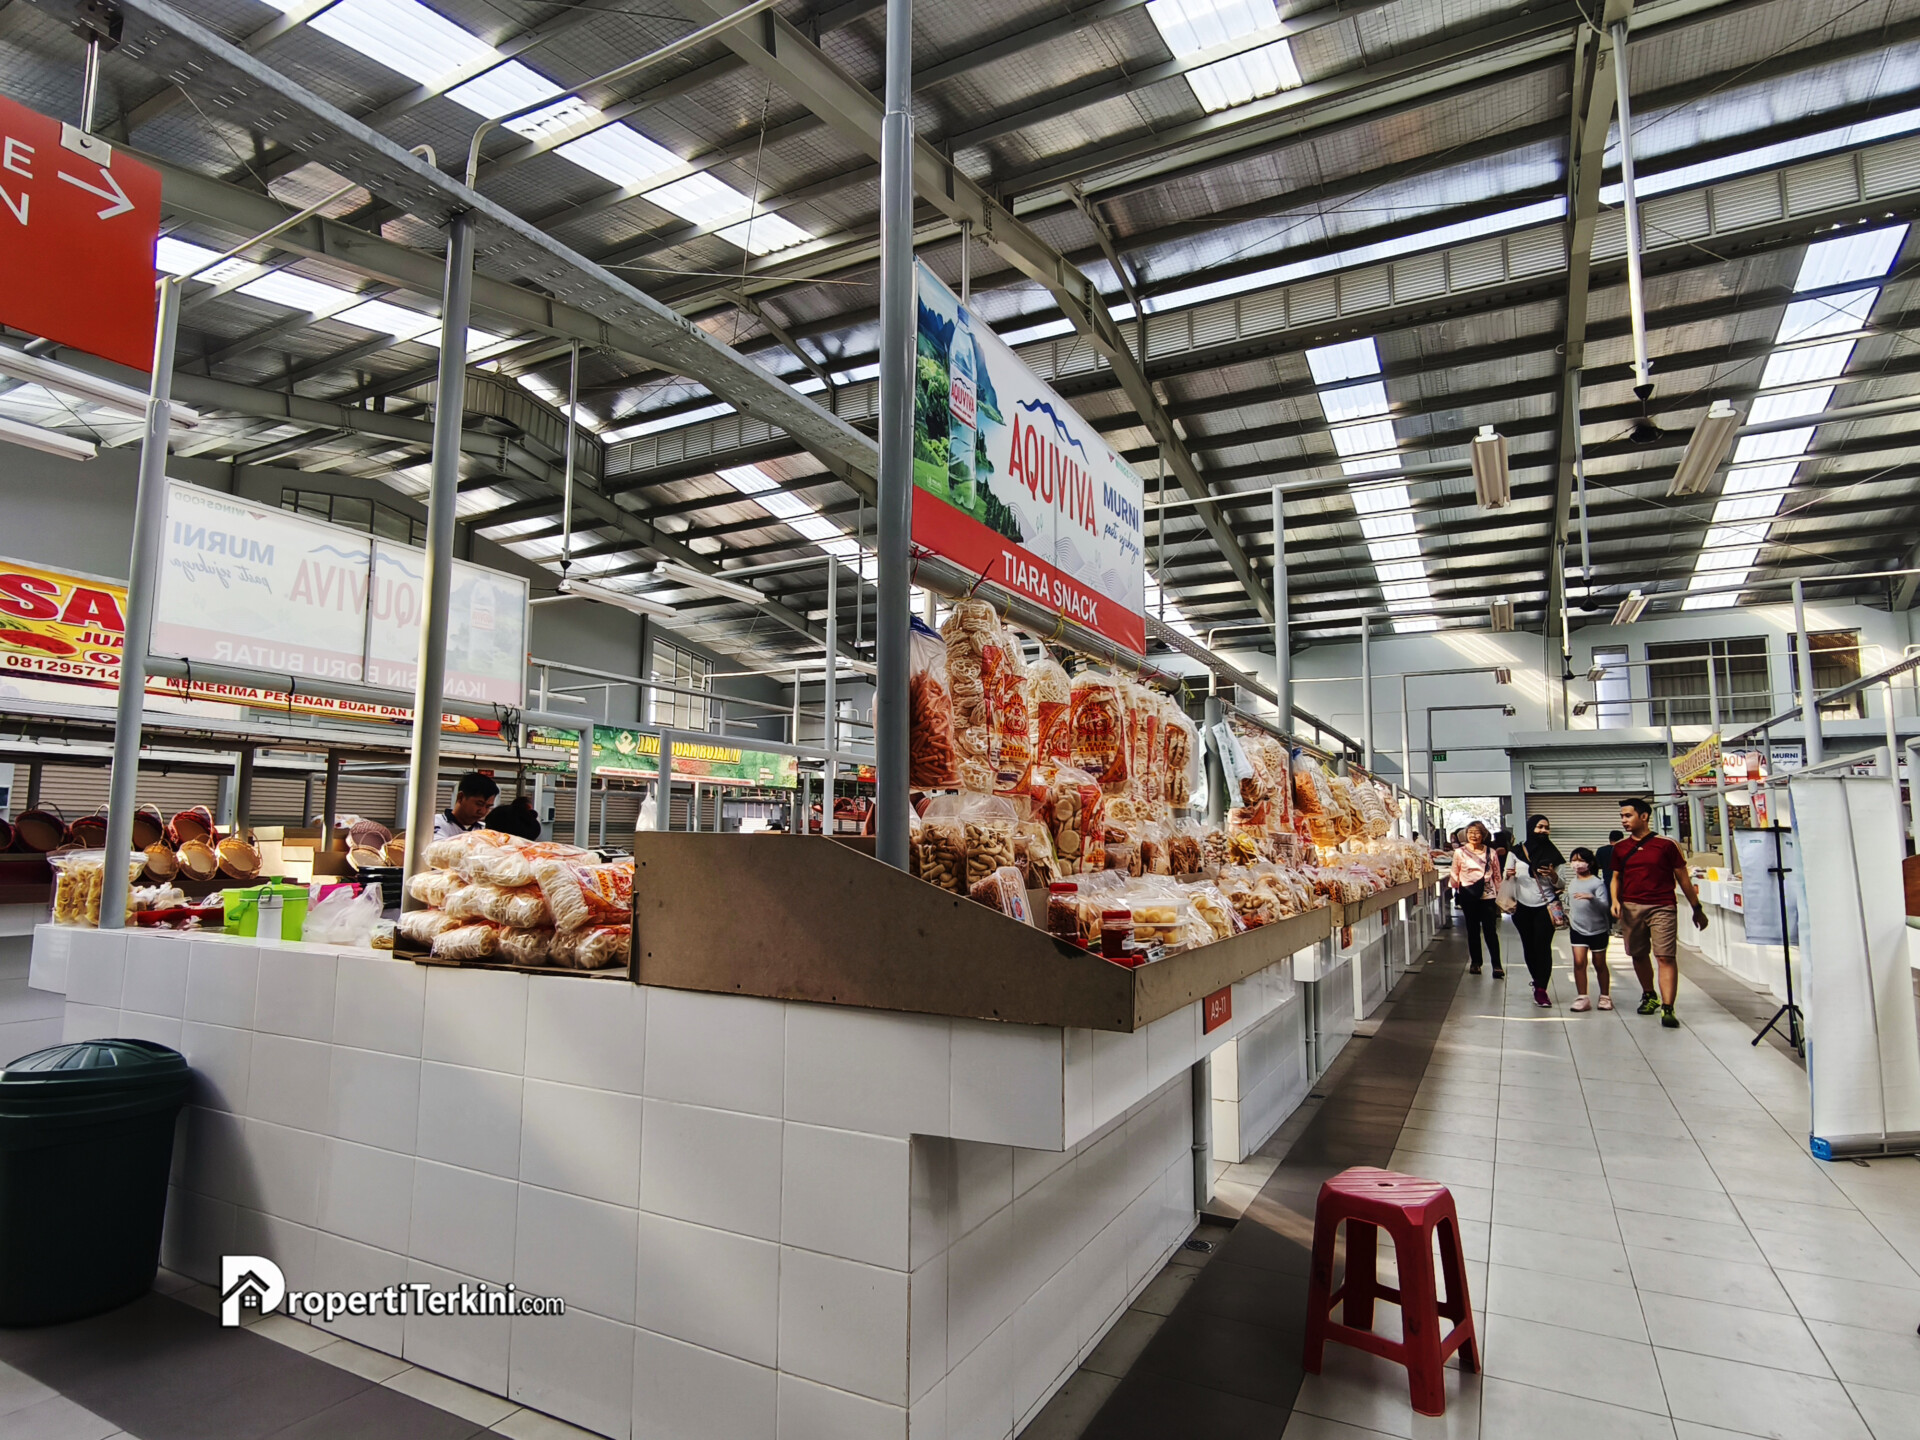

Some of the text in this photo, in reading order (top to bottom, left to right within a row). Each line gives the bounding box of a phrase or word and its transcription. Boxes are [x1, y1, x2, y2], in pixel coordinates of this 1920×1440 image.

[1008, 412, 1097, 536] AQUVIVA
[1103, 480, 1139, 533] MURNI
[0, 573, 128, 634] SA
[1002, 550, 1098, 626] TIARA SNACK
[75, 631, 125, 648] JUA
[7, 654, 156, 685] 0812957147
[166, 677, 259, 699] MENERIMA
[263, 690, 335, 707] PESENAN
[339, 700, 376, 713] BUAH
[380, 705, 407, 717] DAN
[638, 734, 660, 753] JAY
[1692, 776, 1717, 784] WARUN
